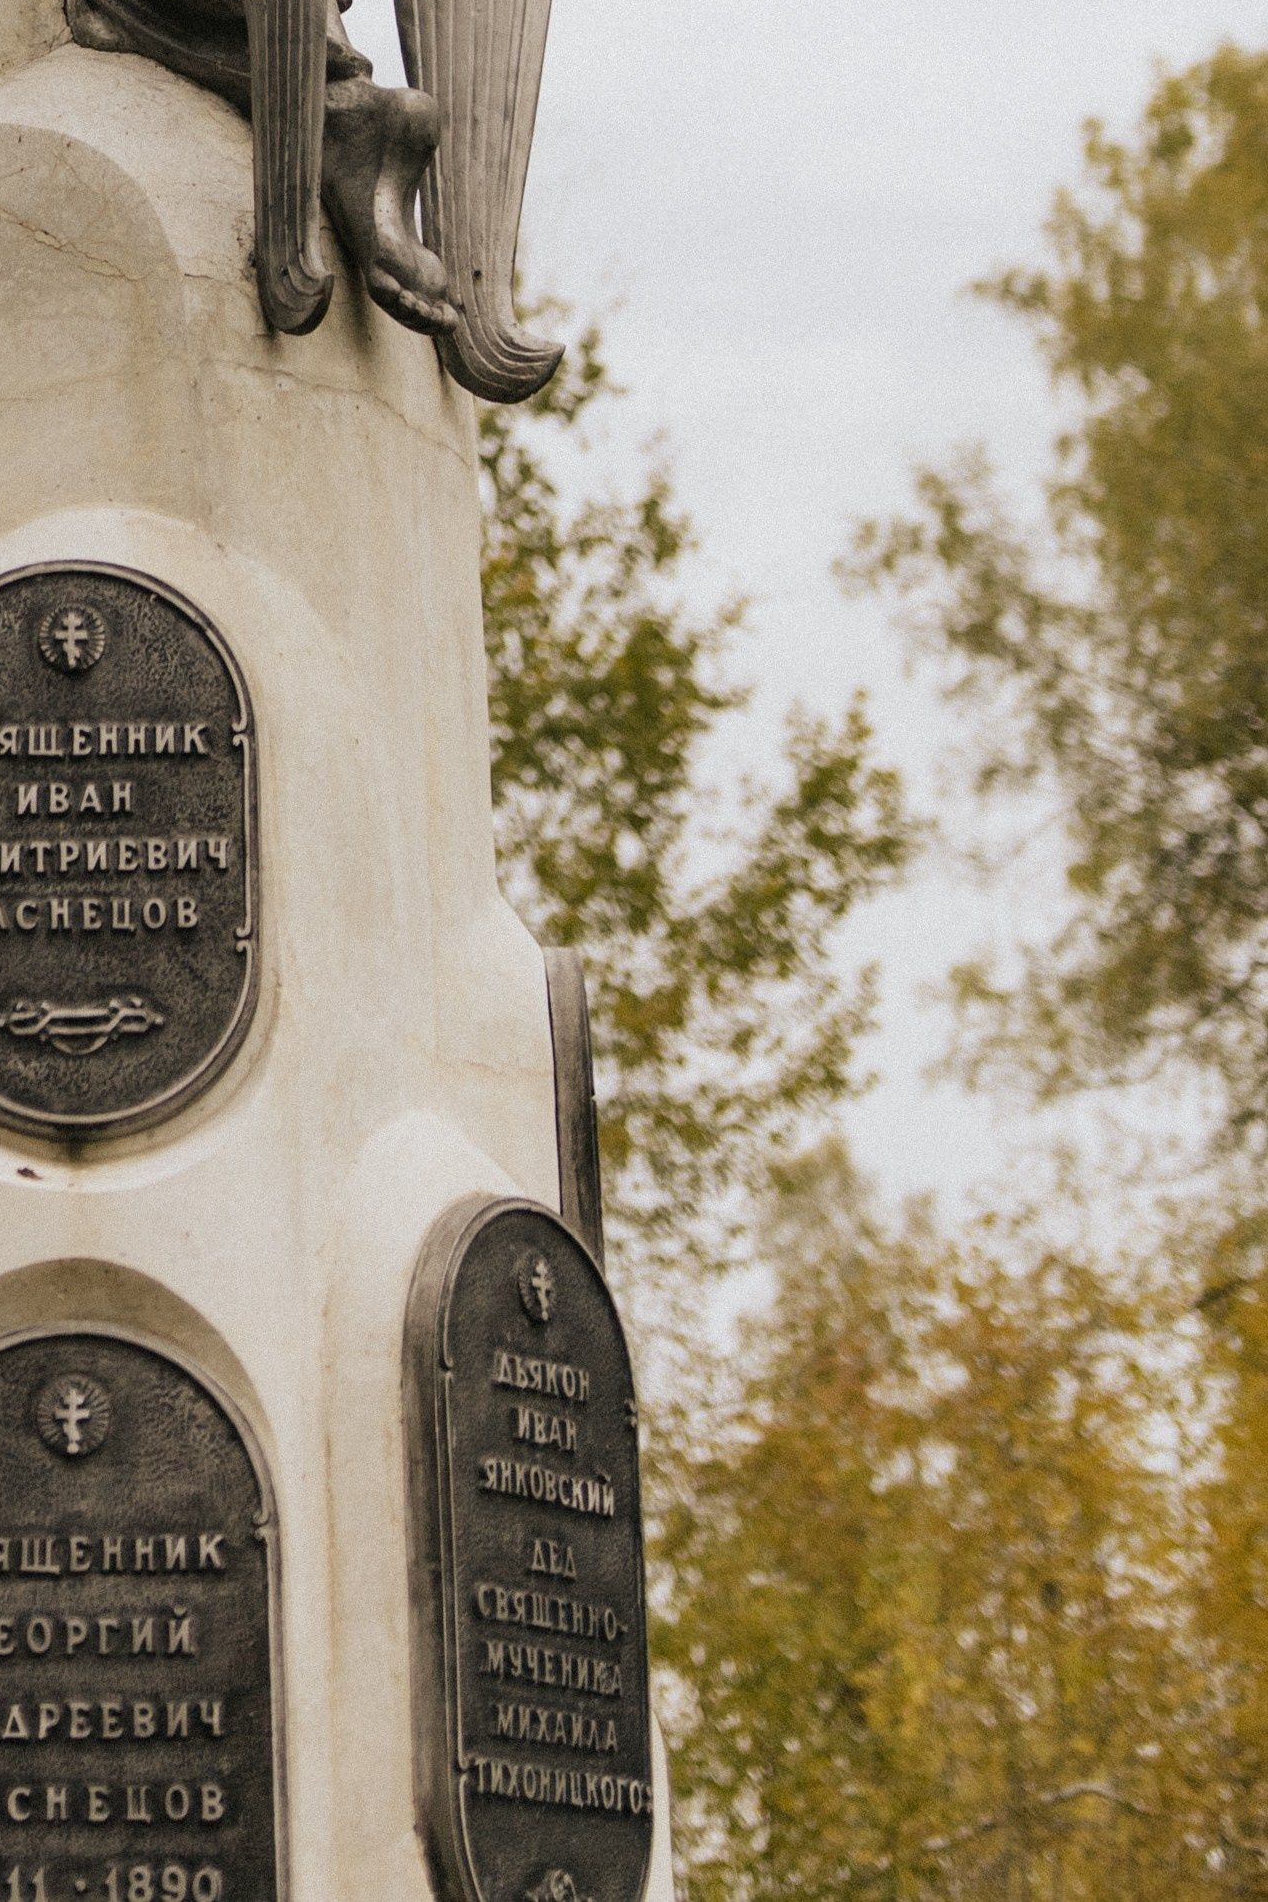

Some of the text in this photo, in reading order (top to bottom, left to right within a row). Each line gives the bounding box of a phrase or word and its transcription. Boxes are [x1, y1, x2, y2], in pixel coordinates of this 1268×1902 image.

[17, 781, 134, 817] ИВАН
[518, 1406, 577, 1451] ИВАН
[483, 1458, 615, 1517] ЯНКОВСКИЙ
[531, 1537, 578, 1580] ДЕД
[485, 1641, 623, 1697] МУЧЕНИКА
[497, 1704, 618, 1752] МИХАИЛА
